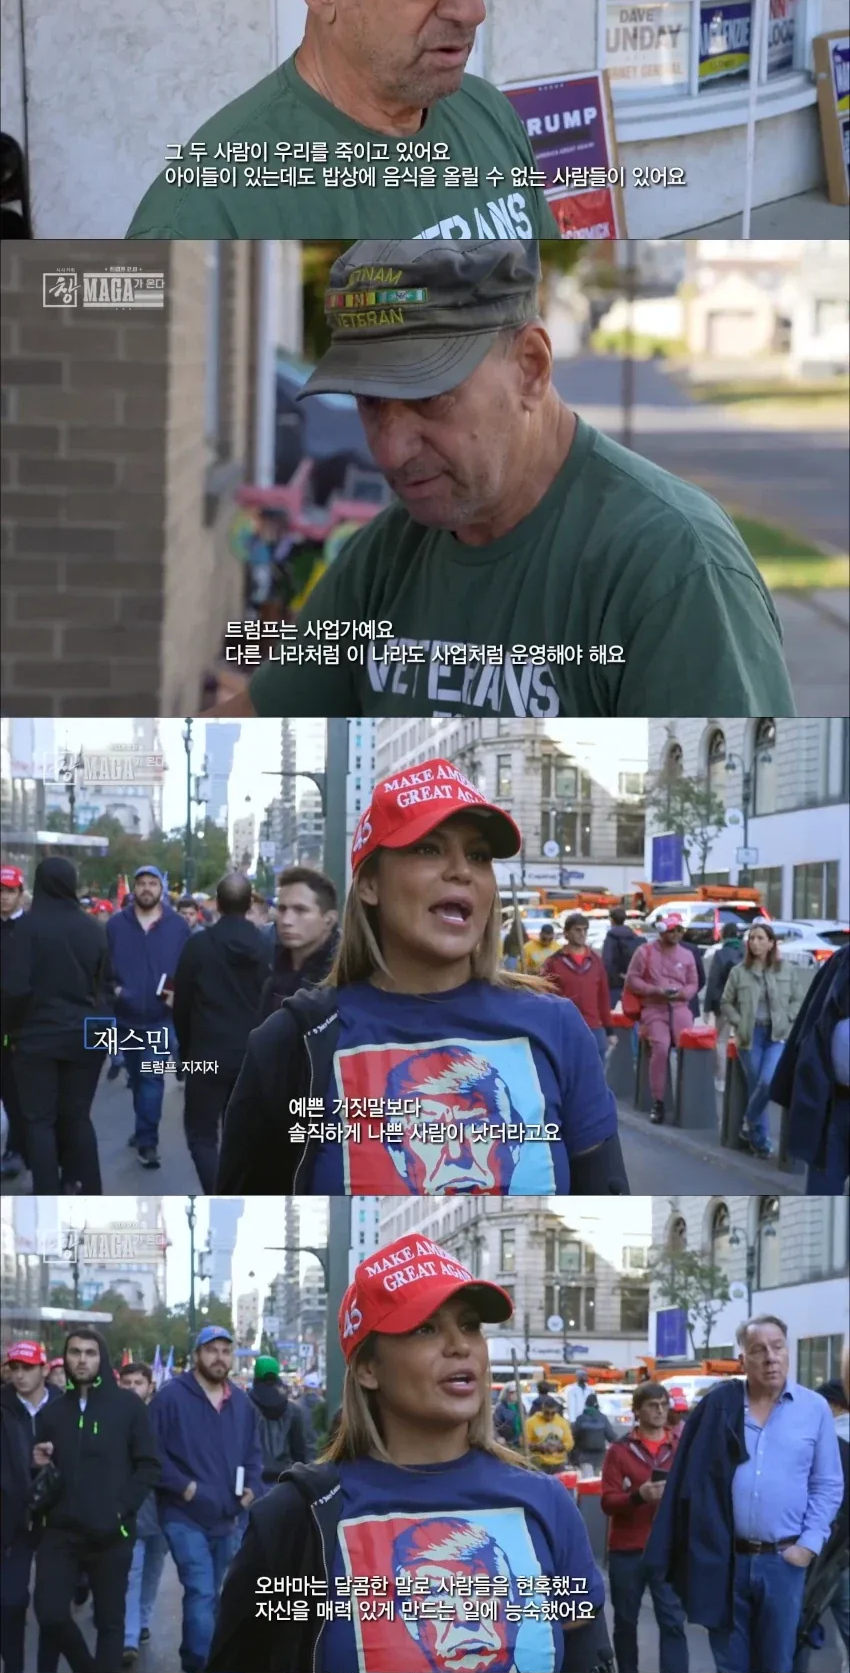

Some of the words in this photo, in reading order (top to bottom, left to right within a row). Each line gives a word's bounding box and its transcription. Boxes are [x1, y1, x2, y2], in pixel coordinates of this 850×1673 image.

[619, 7, 655, 24] DAVE
[606, 24, 683, 53] UNDAY
[526, 107, 598, 136] RUMP
[384, 769, 434, 793] MAKE
[396, 785, 453, 808] GREAT
[364, 1246, 415, 1278] MAKE
[383, 1261, 438, 1292] GREAT
